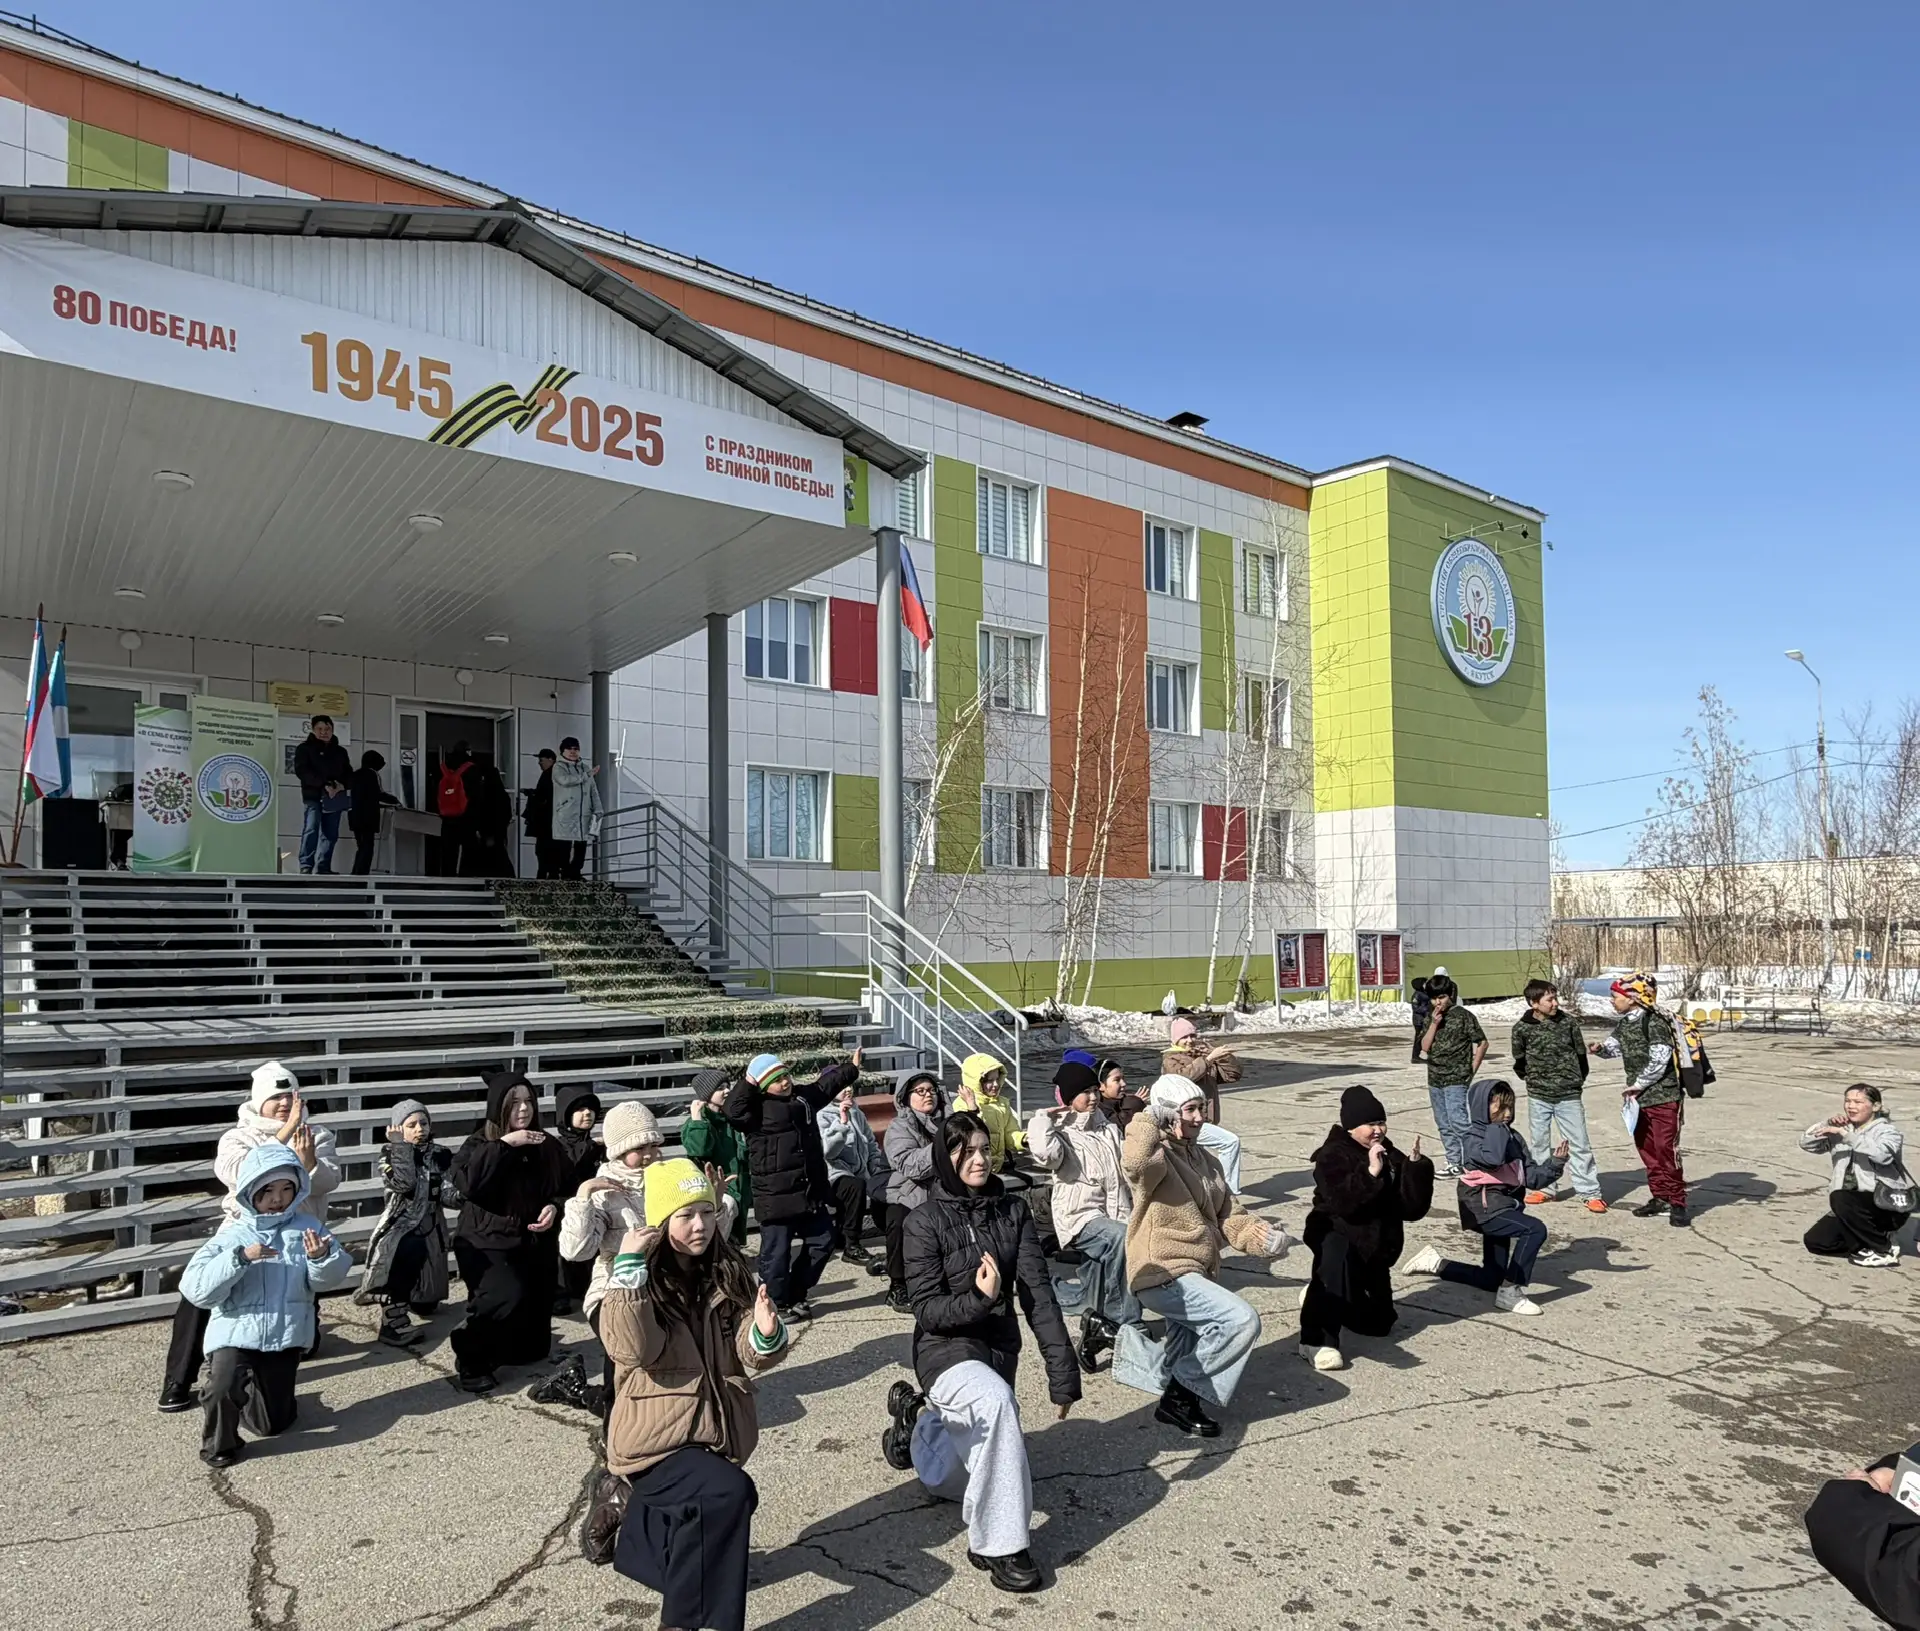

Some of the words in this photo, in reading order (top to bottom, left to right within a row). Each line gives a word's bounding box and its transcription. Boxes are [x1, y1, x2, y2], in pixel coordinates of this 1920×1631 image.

[54, 285, 102, 325] 80
[110, 302, 237, 353] ПОБЕДА!
[301, 331, 454, 419] 1945
[535, 387, 664, 466] 2025
[705, 435, 715, 451] С
[718, 438, 813, 474] ПРАЗДНИКОМ
[705, 455, 771, 485] ВЕЛИКОЙ
[774, 471, 834, 499] ПОБЕДЫ!
[1463, 612, 1493, 658] 13
[222, 787, 249, 809] 13
